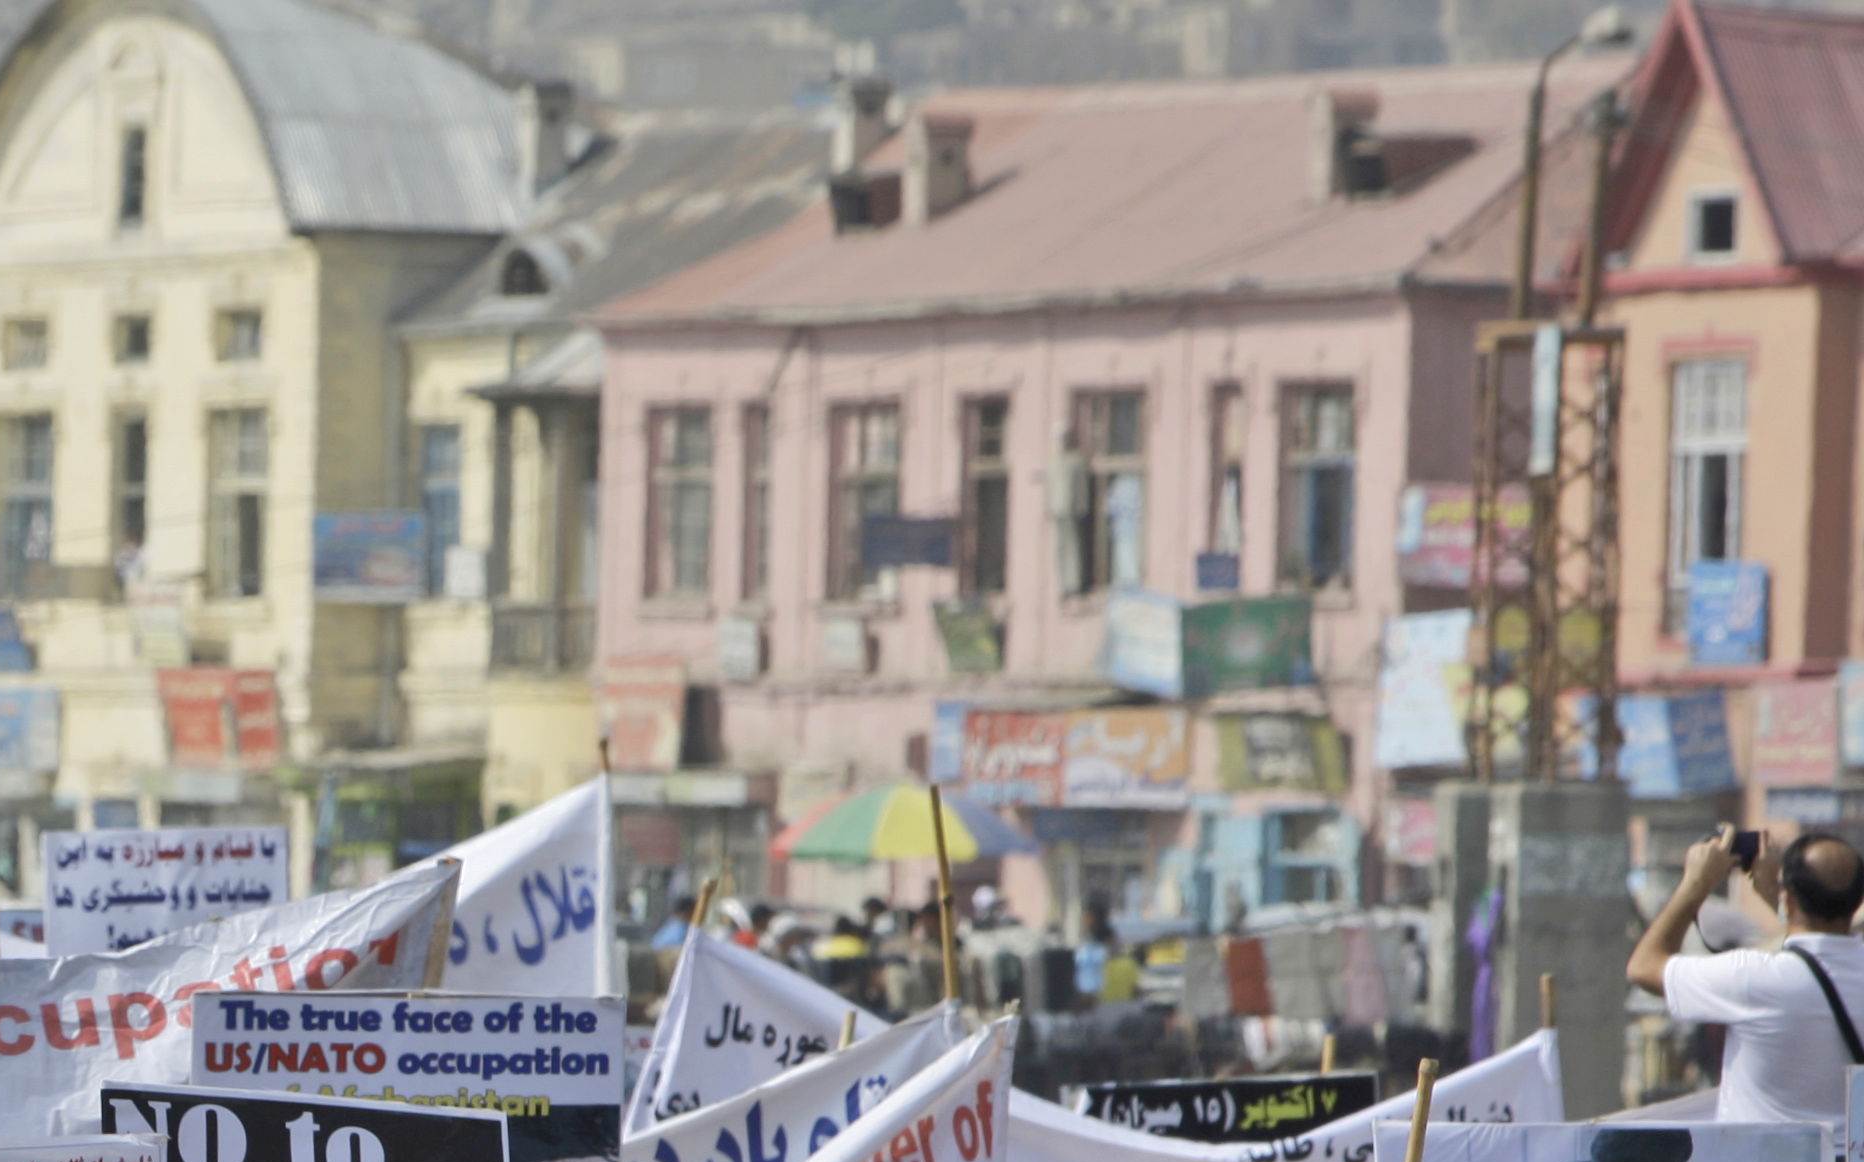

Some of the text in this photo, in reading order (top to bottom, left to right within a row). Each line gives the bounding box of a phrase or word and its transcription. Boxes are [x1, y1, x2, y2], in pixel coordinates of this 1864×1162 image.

[219, 1000, 598, 1033] The true face of the
[204, 1042, 610, 1080] US/NATO occupation
[953, 1080, 993, 1162] of
